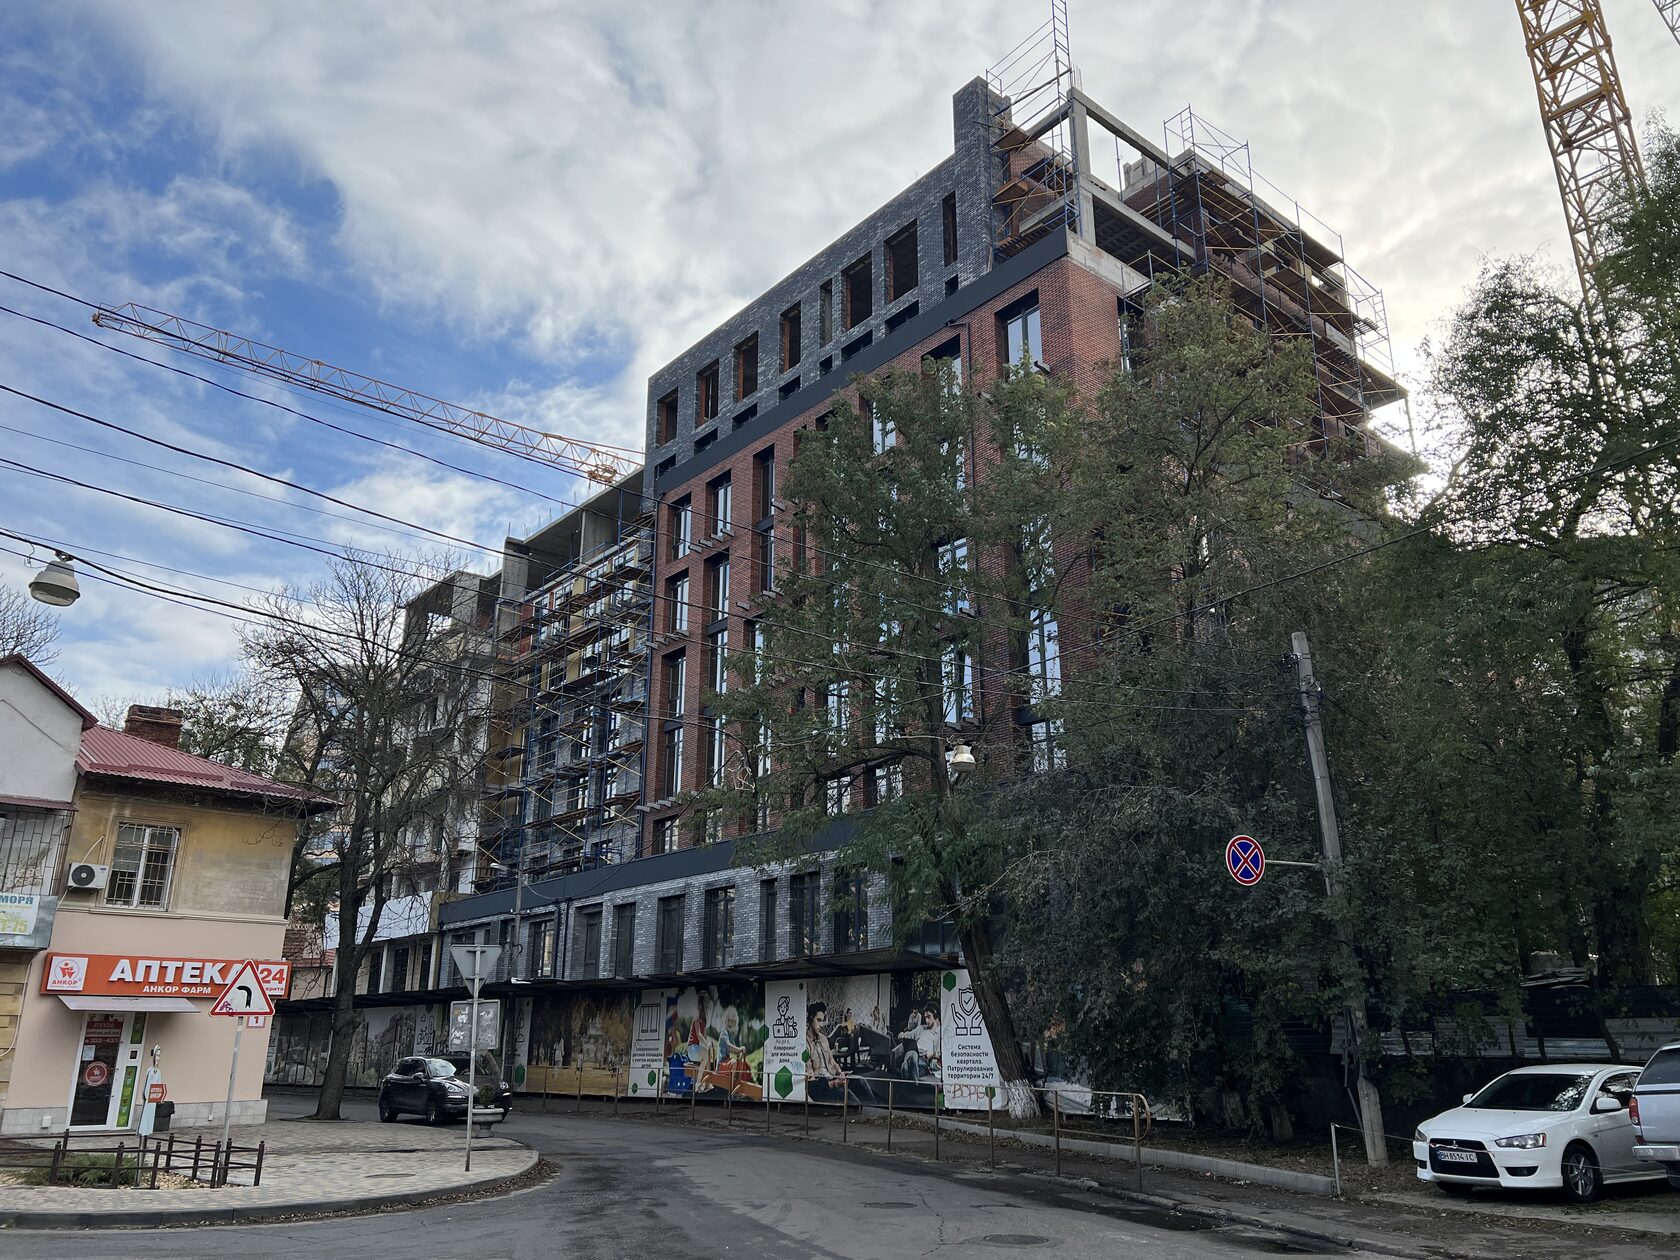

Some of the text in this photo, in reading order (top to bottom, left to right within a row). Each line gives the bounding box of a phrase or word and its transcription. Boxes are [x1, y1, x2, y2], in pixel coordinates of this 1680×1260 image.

[259, 967, 285, 986] 24
[51, 979, 79, 987] АНКОР
[143, 985, 212, 995] АНКОР ФАРМ
[950, 1050, 989, 1058] безопасности
[947, 1065, 994, 1073] Патрулирование
